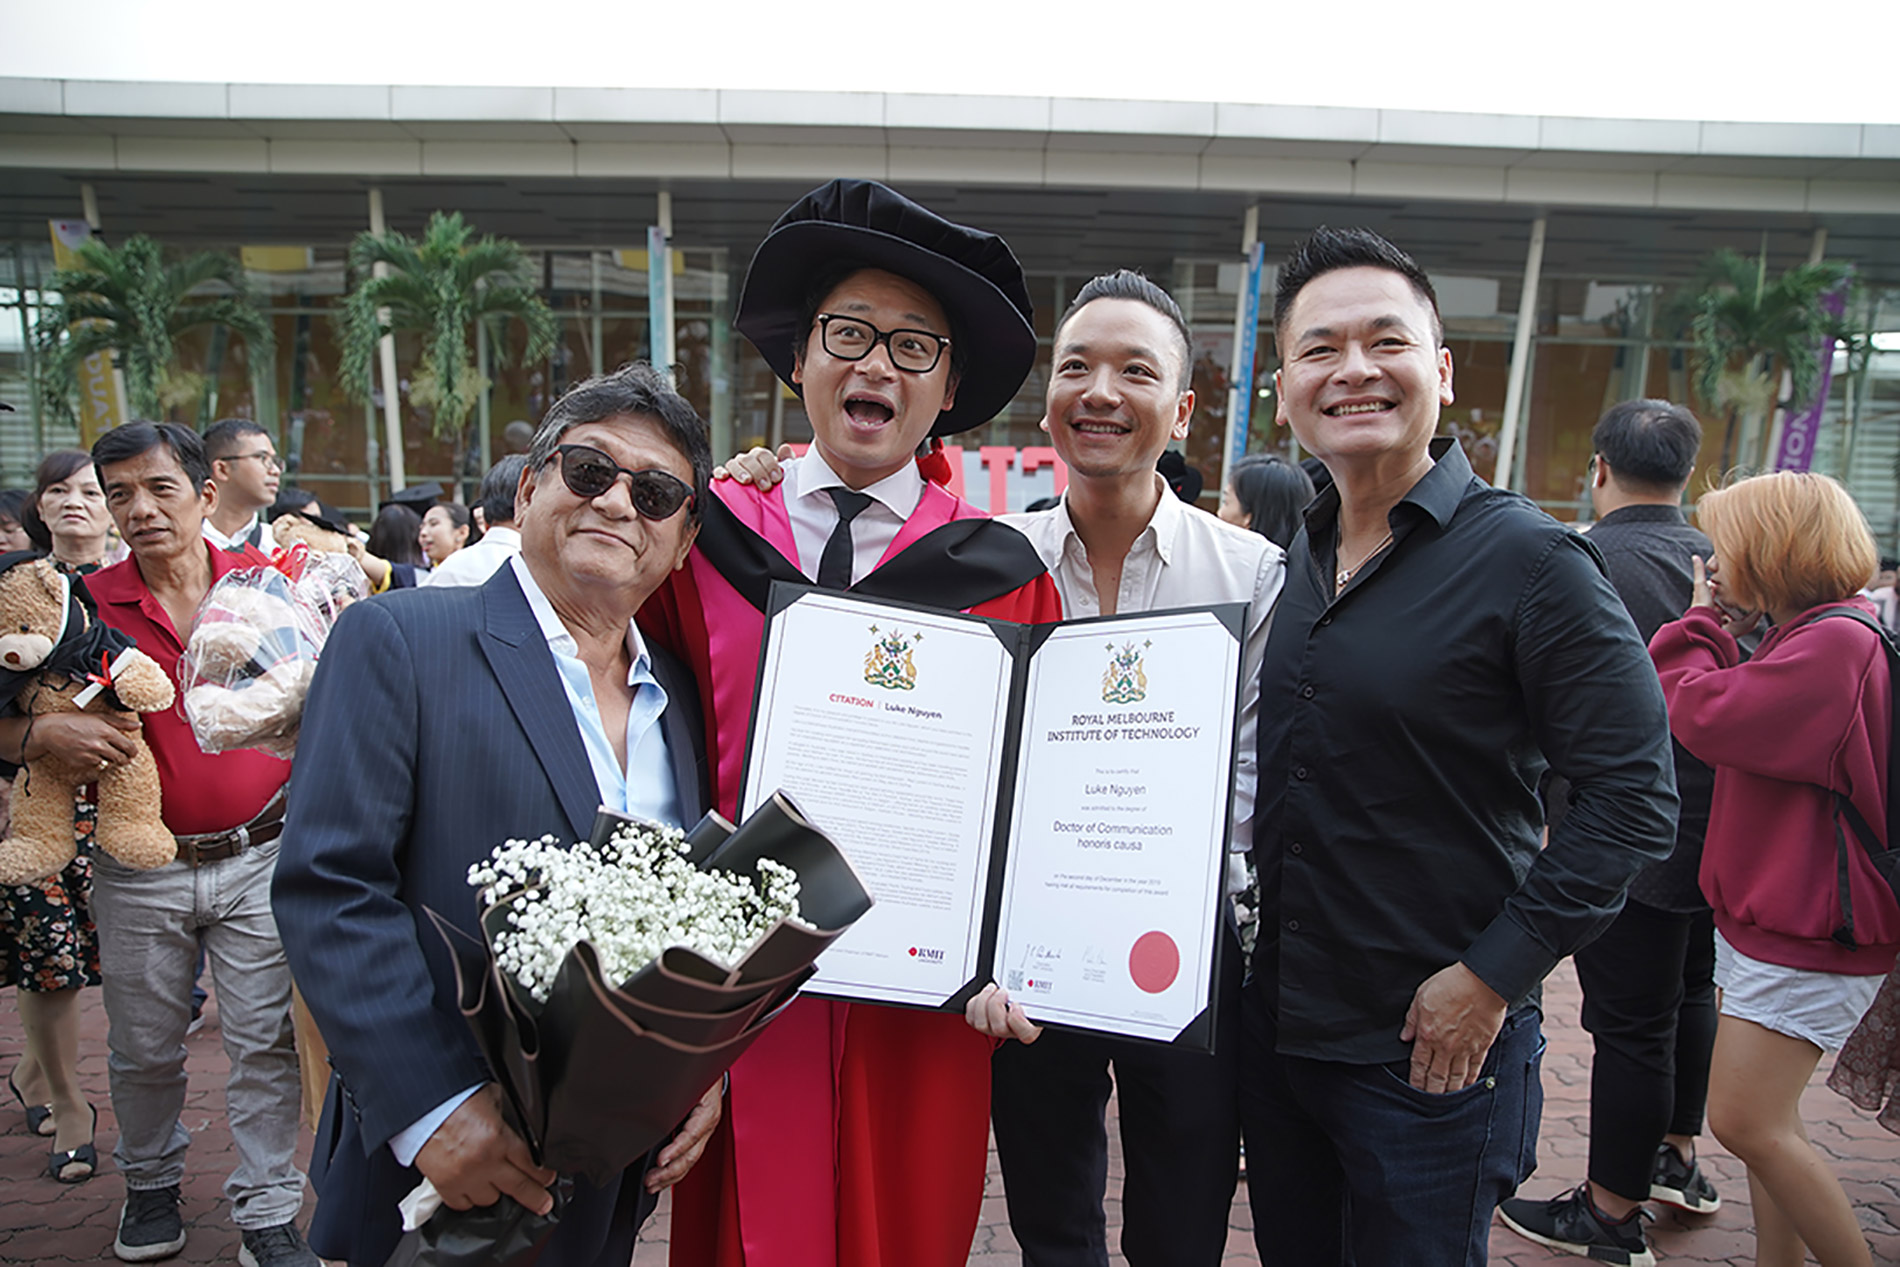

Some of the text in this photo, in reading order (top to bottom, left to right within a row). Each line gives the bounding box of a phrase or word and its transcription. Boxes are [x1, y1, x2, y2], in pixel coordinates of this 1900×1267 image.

[829, 693, 942, 719] CITATION Luke Nguyen
[1072, 711, 1174, 726] ROYAL MELBOURNE
[1047, 726, 1200, 741] INSTITUTE OF TECHNOLOGY
[1084, 783, 1146, 798] Luke Nguyen
[1053, 820, 1173, 836] Doctor of Communication
[1077, 838, 1142, 851] honoris causa
